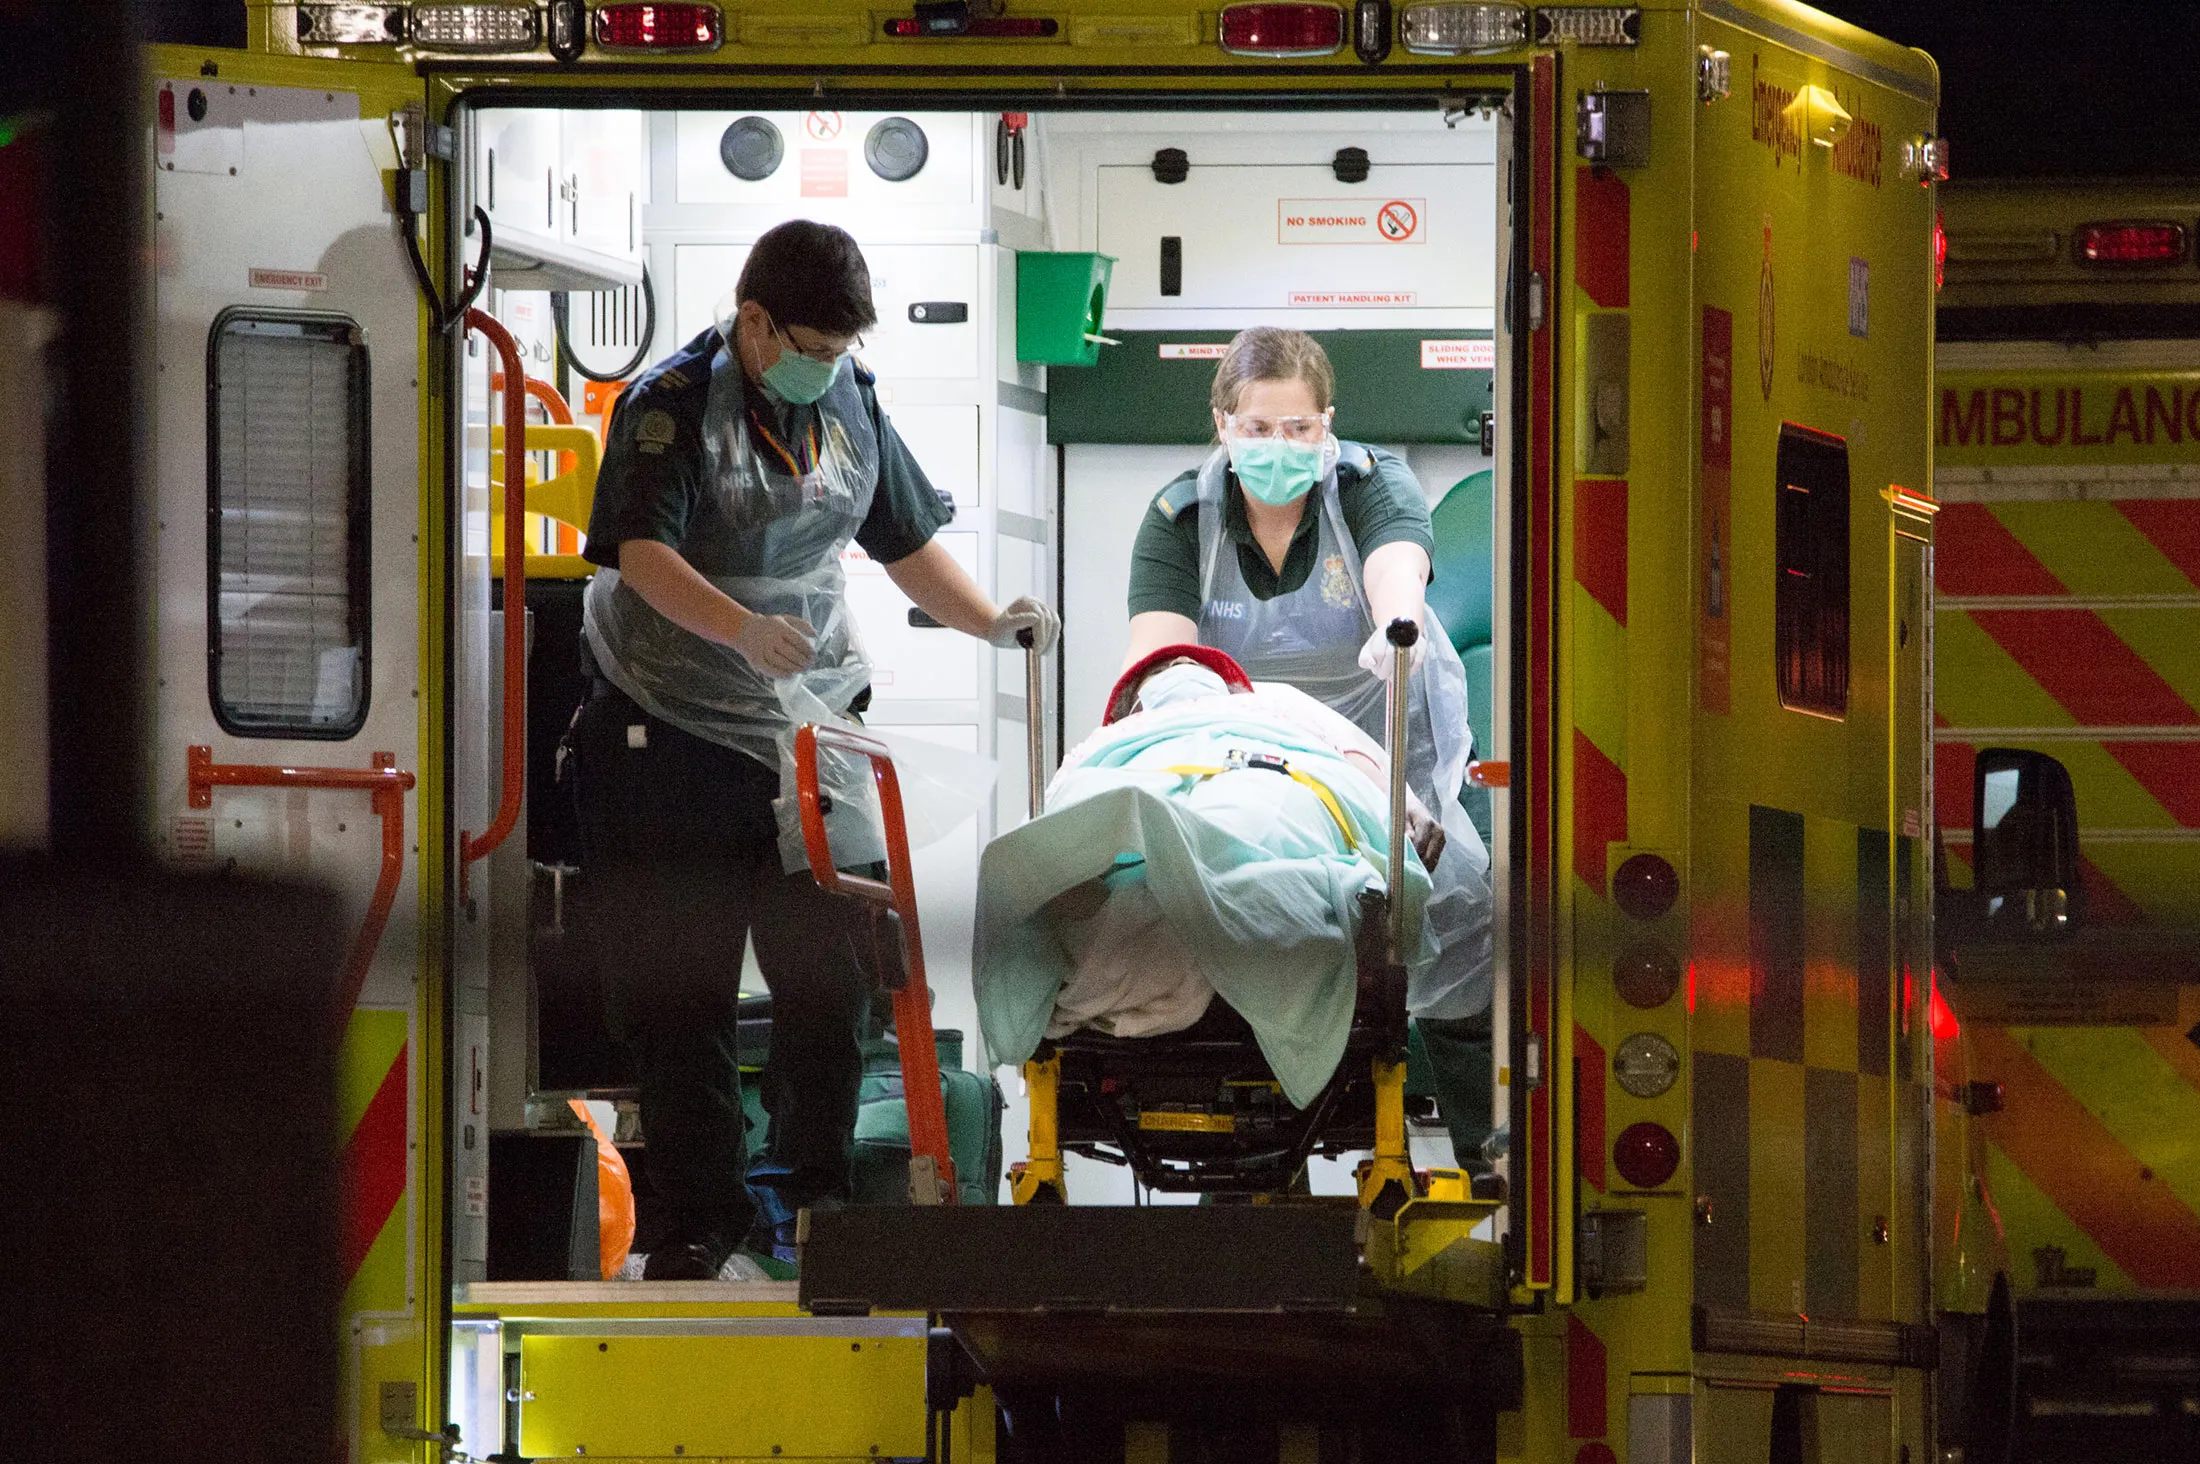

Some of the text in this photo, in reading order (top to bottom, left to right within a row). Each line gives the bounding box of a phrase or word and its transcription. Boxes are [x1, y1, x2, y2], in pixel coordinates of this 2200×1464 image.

[1286, 217, 1366, 226] NO SMOKING
[254, 271, 322, 287] EMERGENCY EXIT
[1294, 295, 1411, 303] PATIENT HANDLING KIT
[1428, 344, 1469, 353] SLIDING
[1935, 386, 2200, 446] MBULAN
[1211, 600, 1243, 618] NHS
